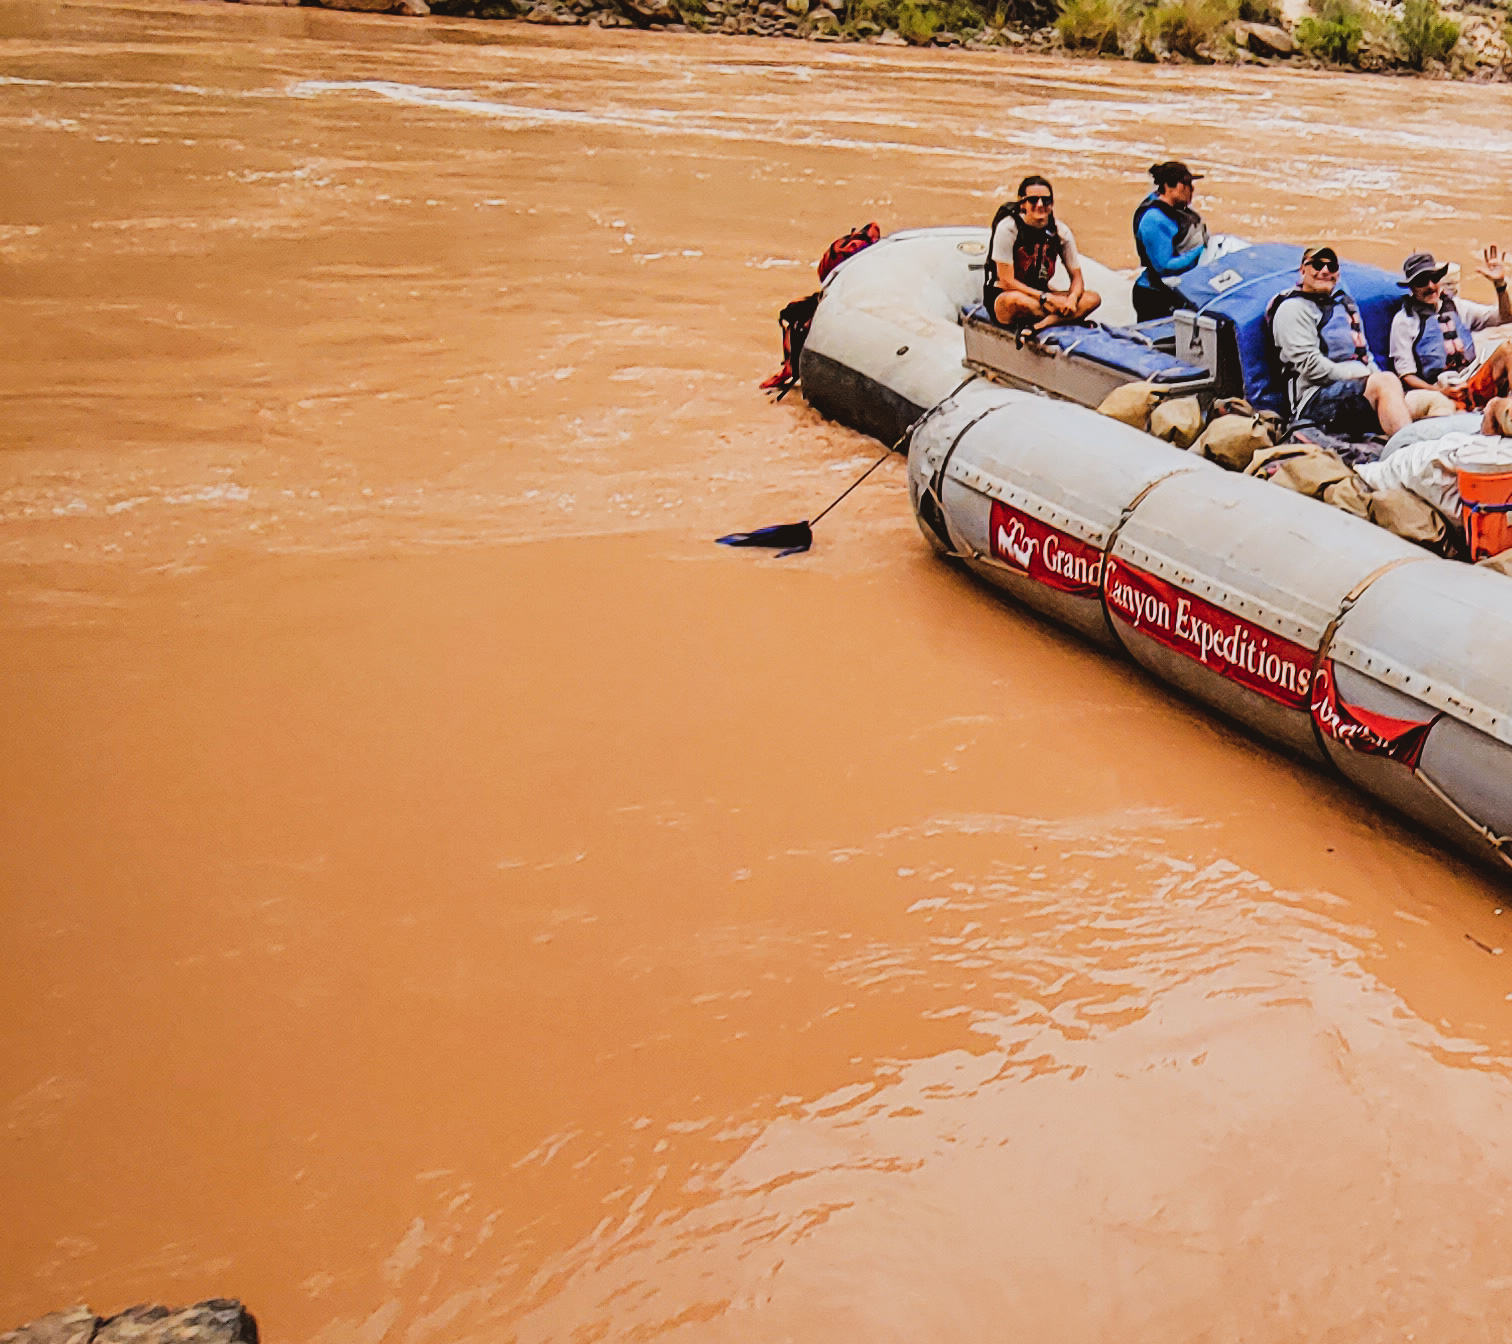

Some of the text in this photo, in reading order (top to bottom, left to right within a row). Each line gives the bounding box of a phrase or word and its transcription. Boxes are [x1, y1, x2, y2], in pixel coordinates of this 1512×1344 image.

[1043, 534, 1311, 695] Grand Canyon Expeditions
